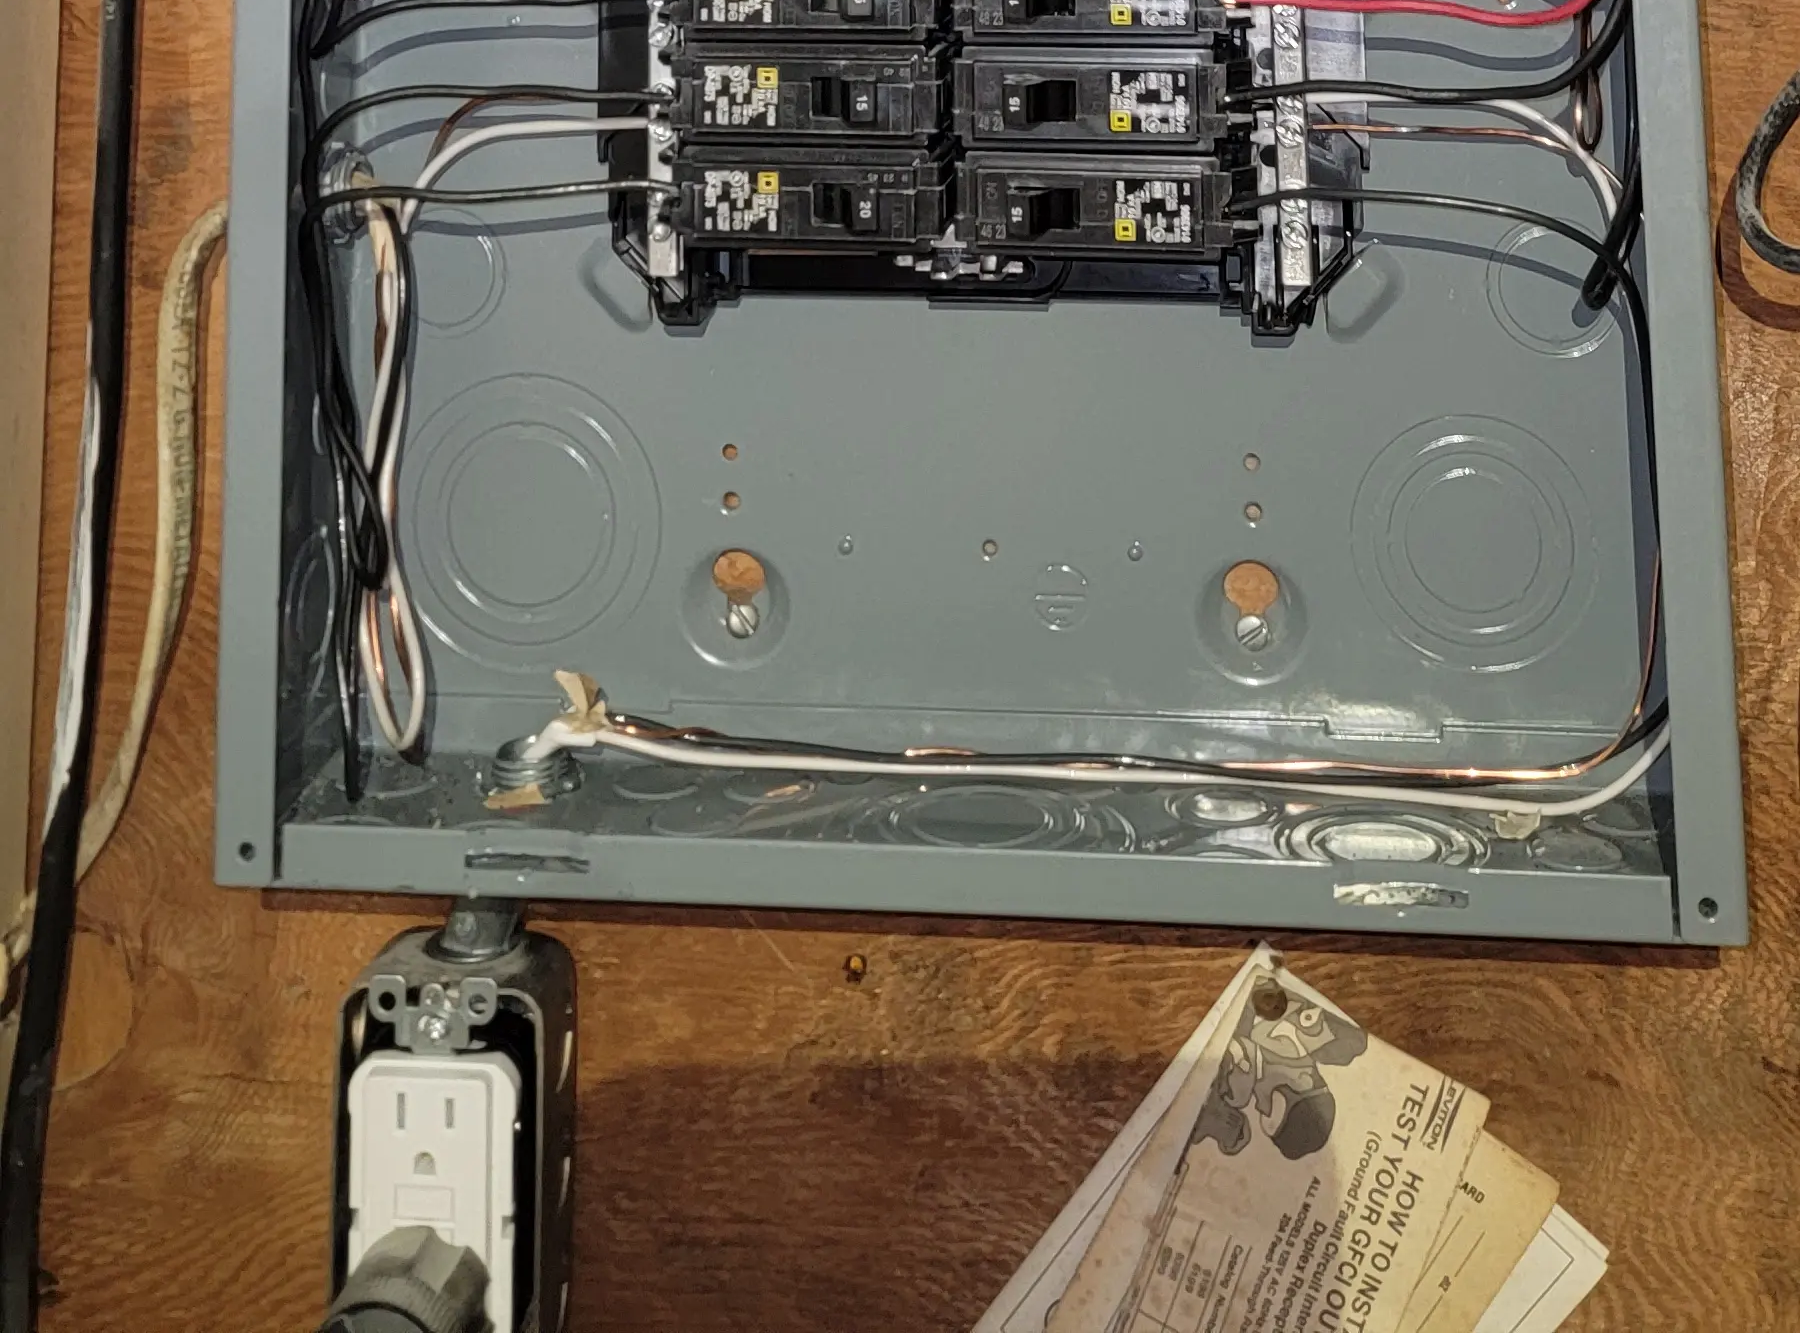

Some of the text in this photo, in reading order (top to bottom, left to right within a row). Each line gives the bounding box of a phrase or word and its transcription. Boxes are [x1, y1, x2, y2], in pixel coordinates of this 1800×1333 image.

[856, 95, 869, 112] 15
[1008, 96, 1021, 113] 15
[859, 200, 872, 219] 20
[1011, 206, 1023, 223] 15
[1390, 1083, 1430, 1151] TEST
[1304, 1175, 1322, 1199] ALL
[1360, 1154, 1403, 1226] YOUR
[1387, 1169, 1425, 1238] HOW
[1458, 1182, 1486, 1204] ARD
[1287, 1199, 1313, 1247] MODELS
[1293, 1130, 1383, 1333] (Ground Fault Circuit Inter
[1296, 1219, 1328, 1274] Duplex
[1333, 1228, 1372, 1288] GFCI
[1371, 1238, 1399, 1273] TO
